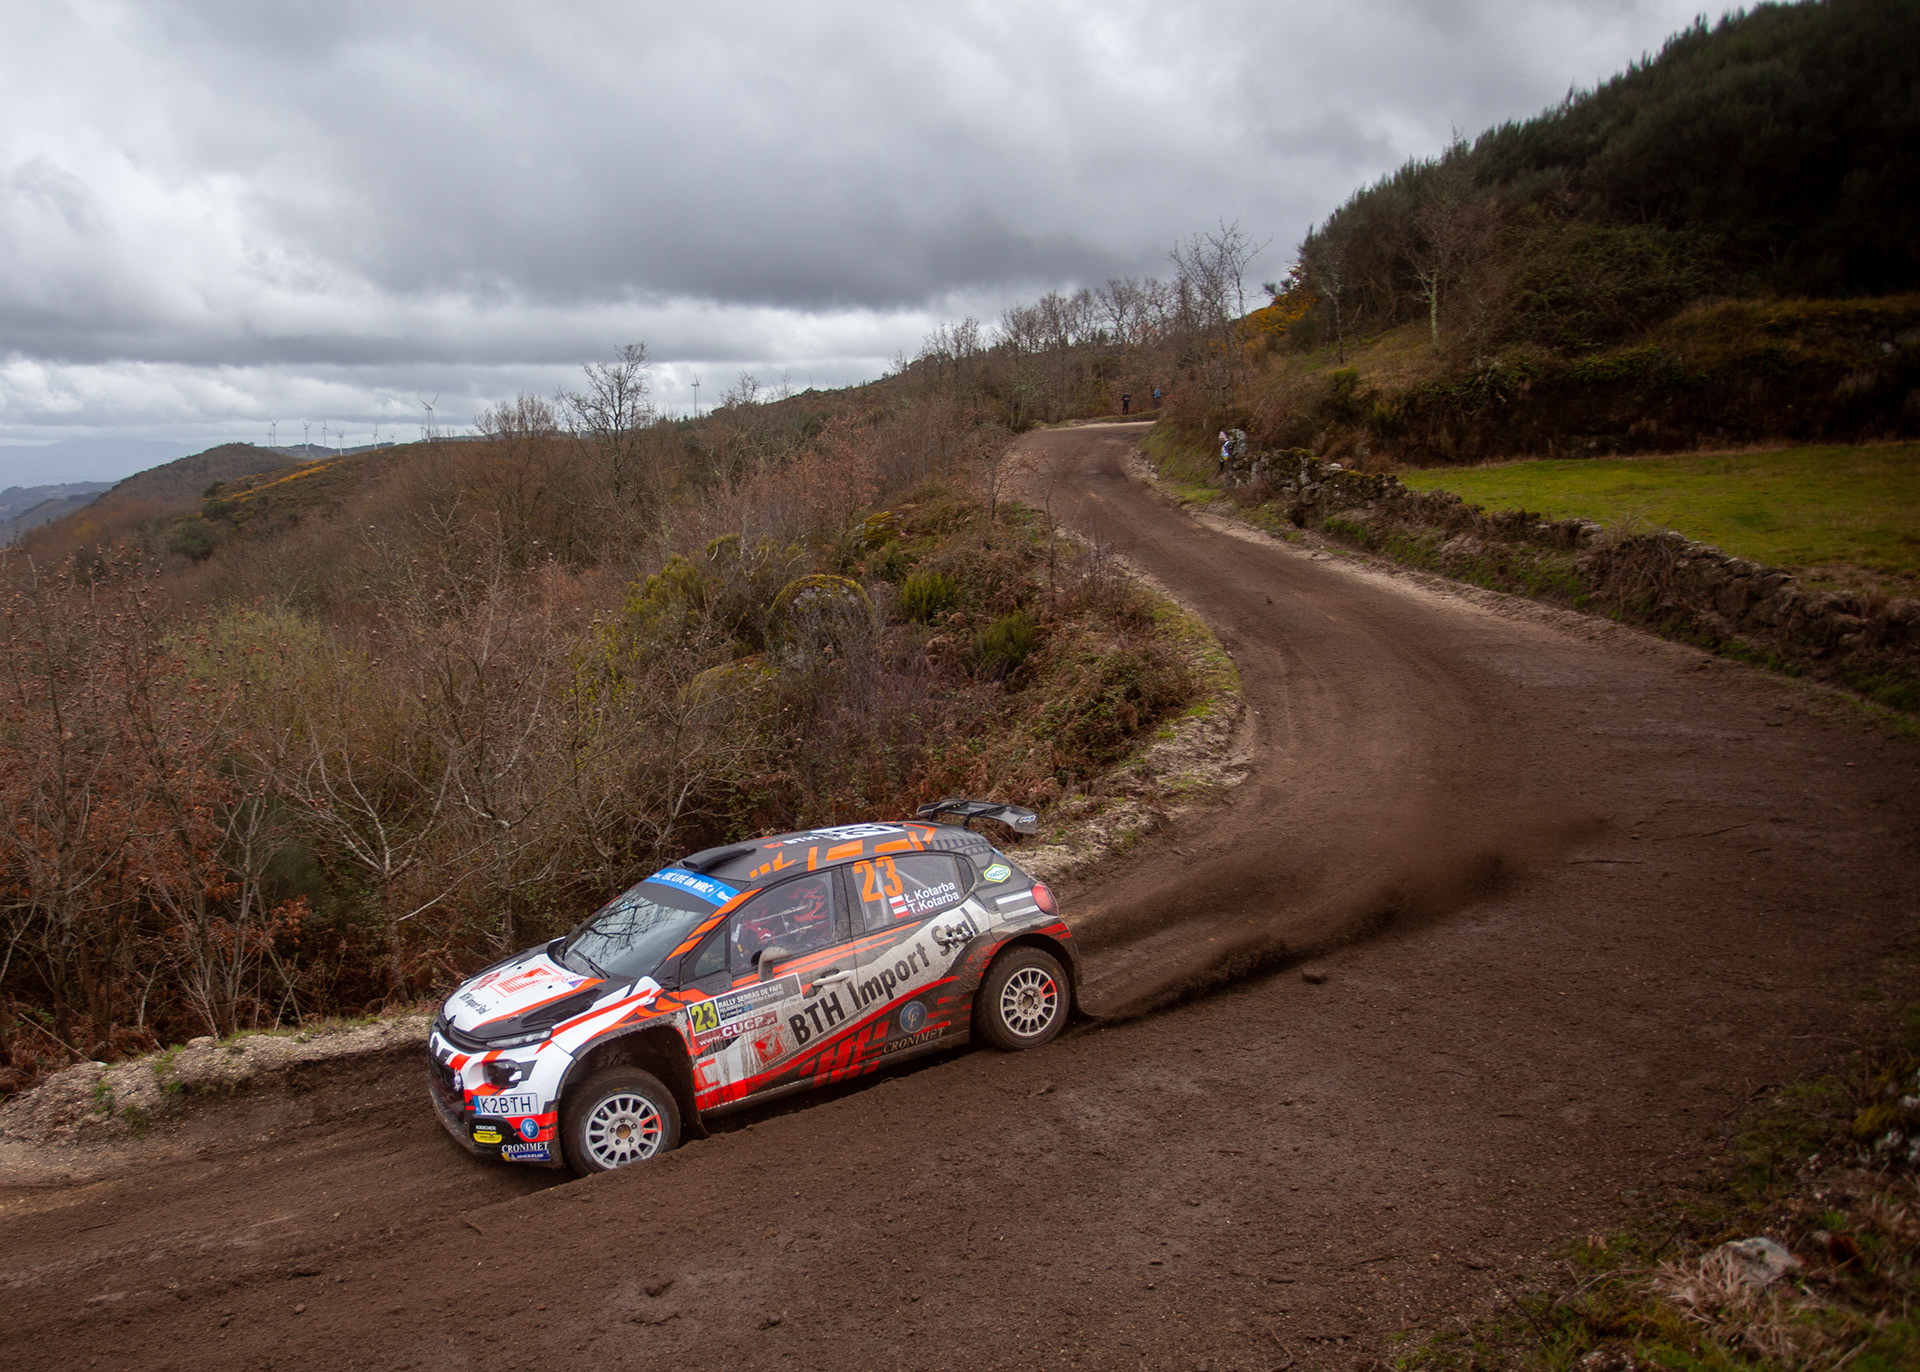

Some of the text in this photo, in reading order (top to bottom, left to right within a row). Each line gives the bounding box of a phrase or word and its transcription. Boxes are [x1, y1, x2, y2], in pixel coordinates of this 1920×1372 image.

[671, 873, 690, 884] LIVE
[683, 877, 698, 887] ON
[853, 856, 904, 903] 23
[988, 868, 1008, 878] YACCO
[904, 881, 956, 903] Ł.Kotarba
[908, 892, 960, 914] T.Kotarba
[788, 907, 980, 1046] BTH Import Stal
[718, 983, 784, 1009] RALLY SERRAS DE FAFE
[691, 1002, 718, 1033] 23
[699, 1015, 775, 1046] www.CUCP.pt
[883, 1027, 946, 1054] CRONIMET
[480, 1096, 532, 1114] K2BTH
[501, 1141, 550, 1153] CRONIMET
